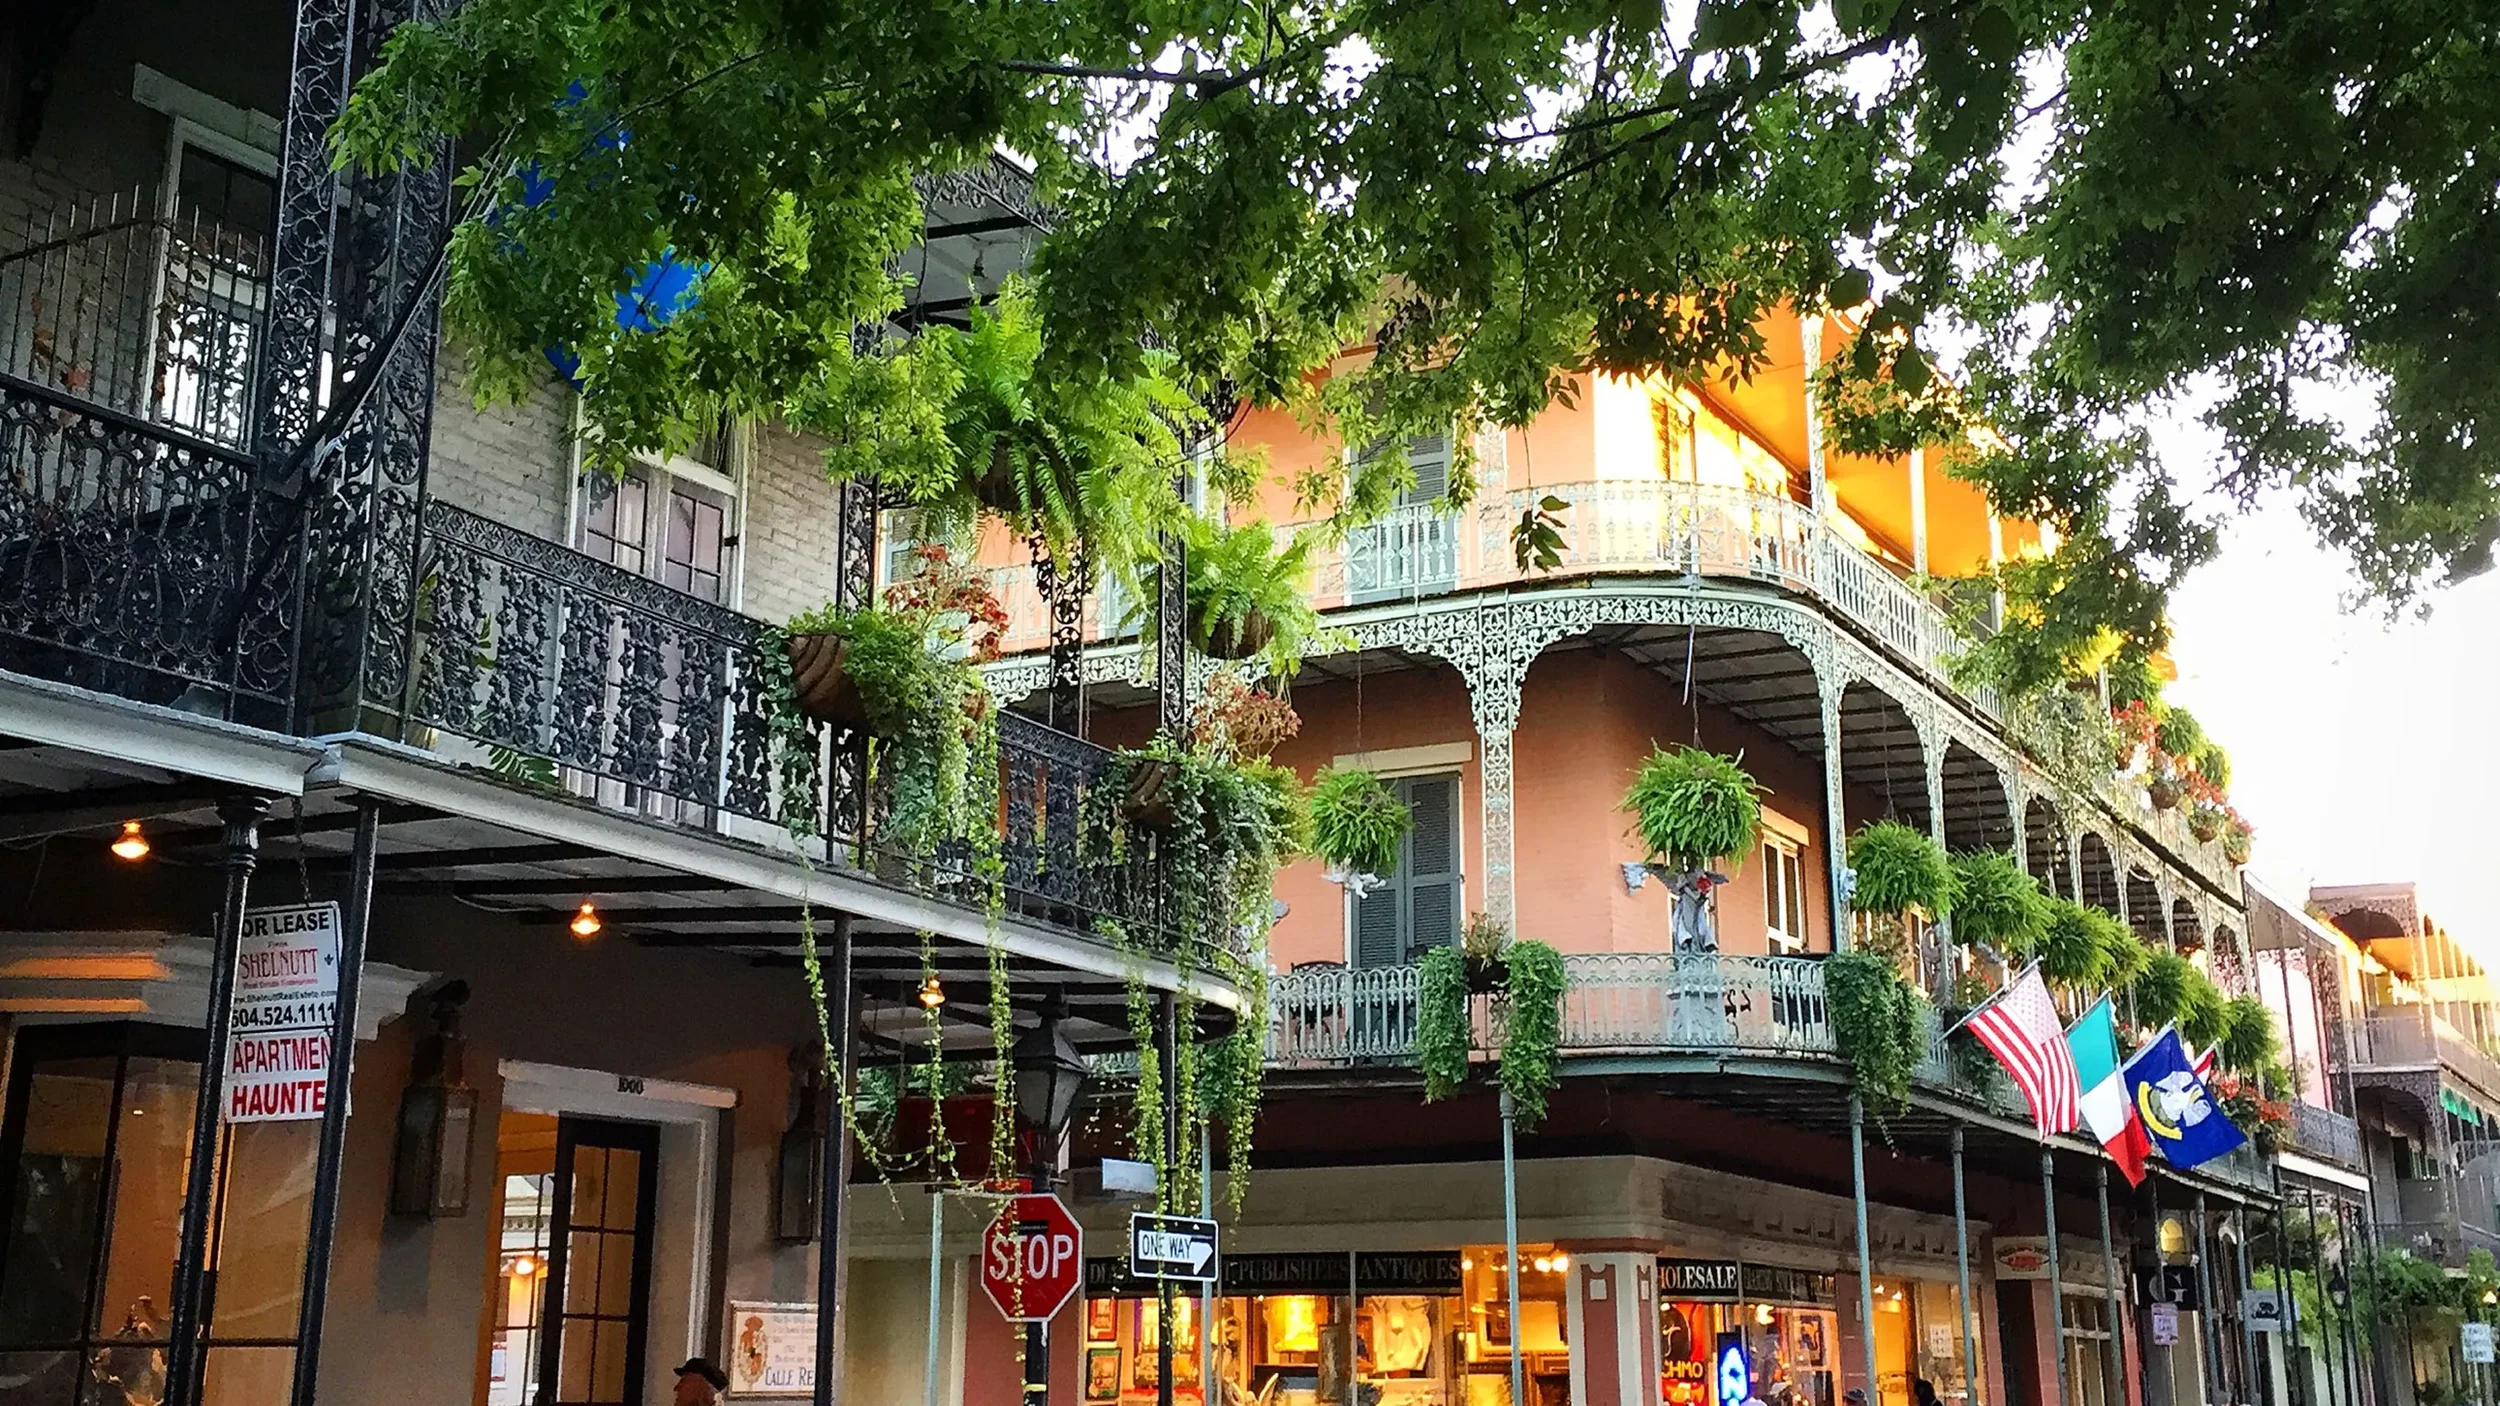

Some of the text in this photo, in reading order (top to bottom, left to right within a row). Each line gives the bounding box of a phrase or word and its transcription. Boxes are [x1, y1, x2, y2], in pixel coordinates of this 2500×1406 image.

[242, 911, 330, 937] OR LEASE
[240, 948, 318, 979] SHELNUTT
[232, 1036, 332, 1074] APARTMEN
[232, 1080, 326, 1117] HAUNTE
[989, 1233, 1074, 1280] STOP
[1142, 1233, 1192, 1260] ONE WAY
[1239, 1257, 1349, 1282] PUBLISHERS
[1358, 1257, 1460, 1283] ANTIQUES
[1659, 1265, 1737, 1290] HOLESALE
[765, 1366, 815, 1386] CALLE RE
[1661, 1360, 1703, 1378] CHMO
